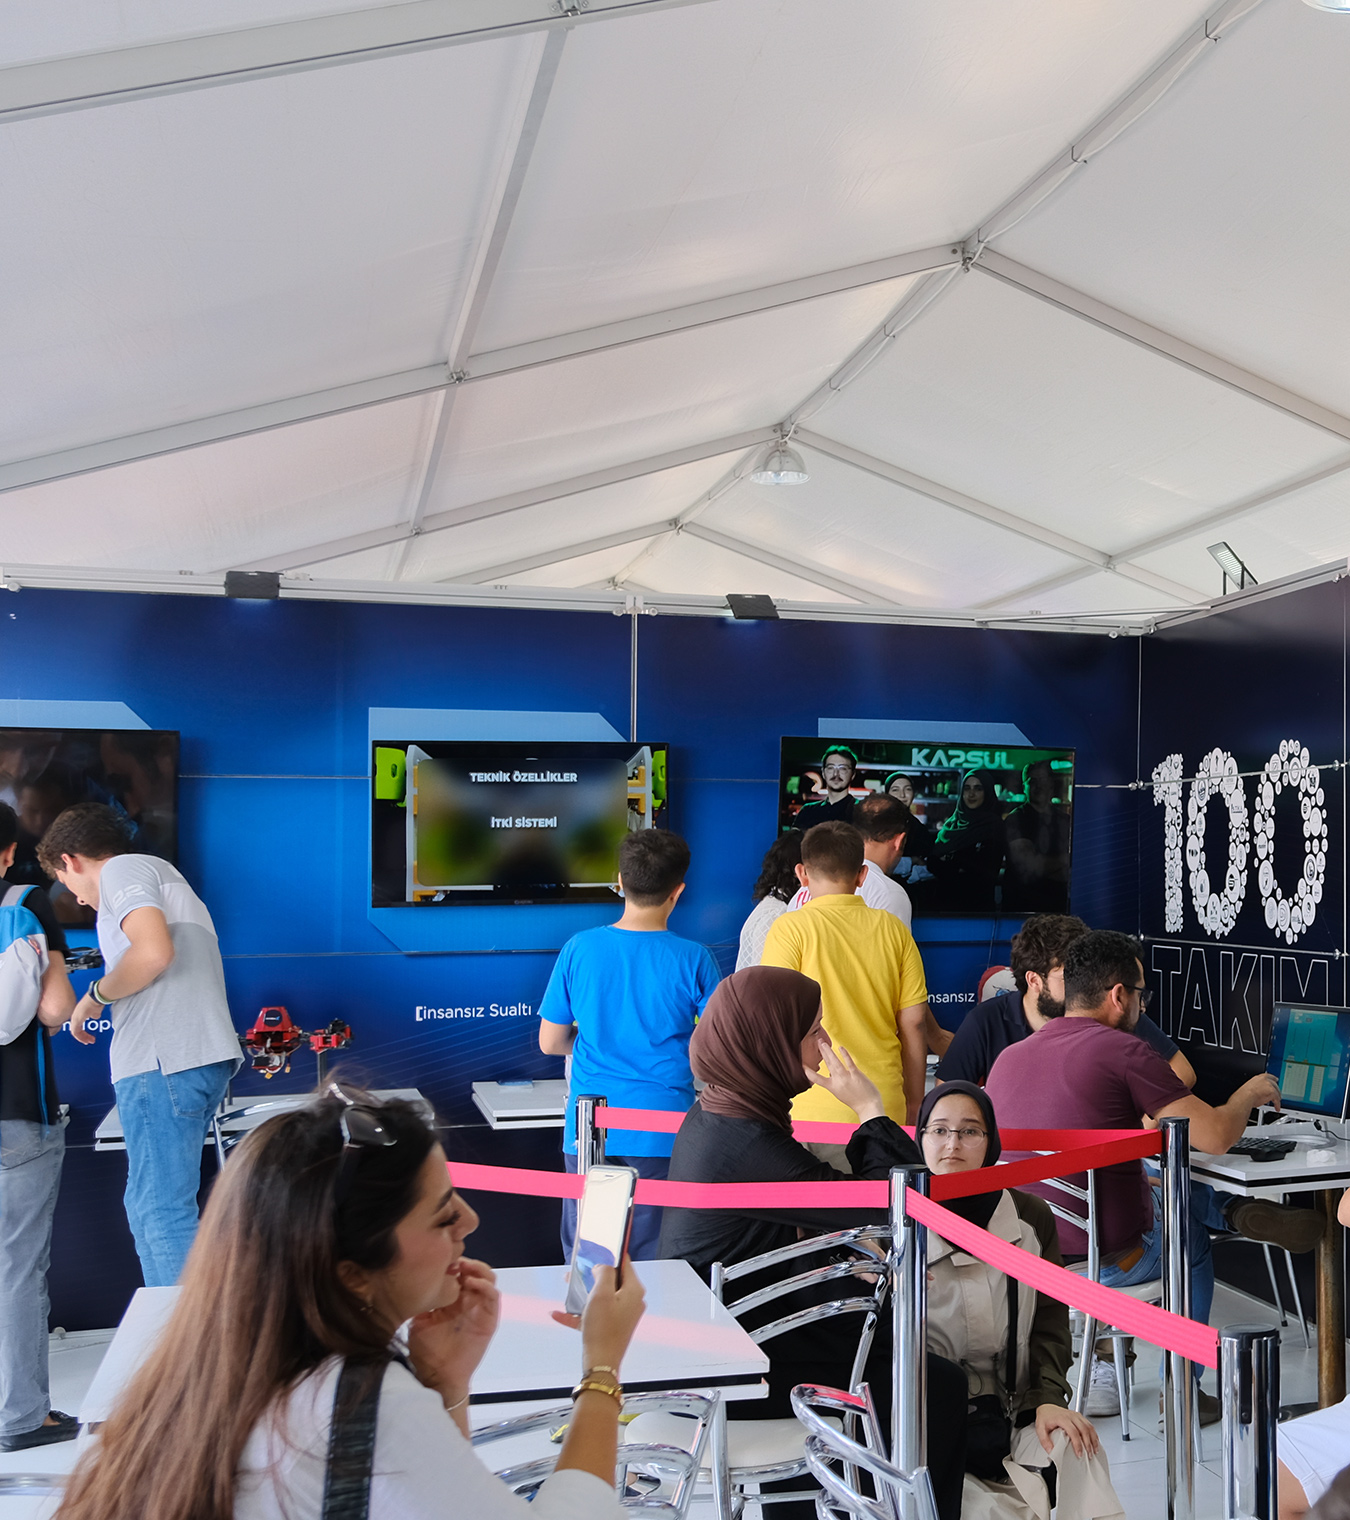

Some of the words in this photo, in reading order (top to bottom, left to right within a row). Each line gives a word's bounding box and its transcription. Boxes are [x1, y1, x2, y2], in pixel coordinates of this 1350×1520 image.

[911, 748, 1014, 769] KAPSUL
[469, 770, 511, 783] TEKNİK
[513, 770, 578, 783] ÖZELLİKLER
[491, 816, 513, 828] İTKİ
[515, 816, 557, 828] SİSTEMİ
[928, 992, 975, 1004] nsansız
[489, 1002, 532, 1017] Sualtı
